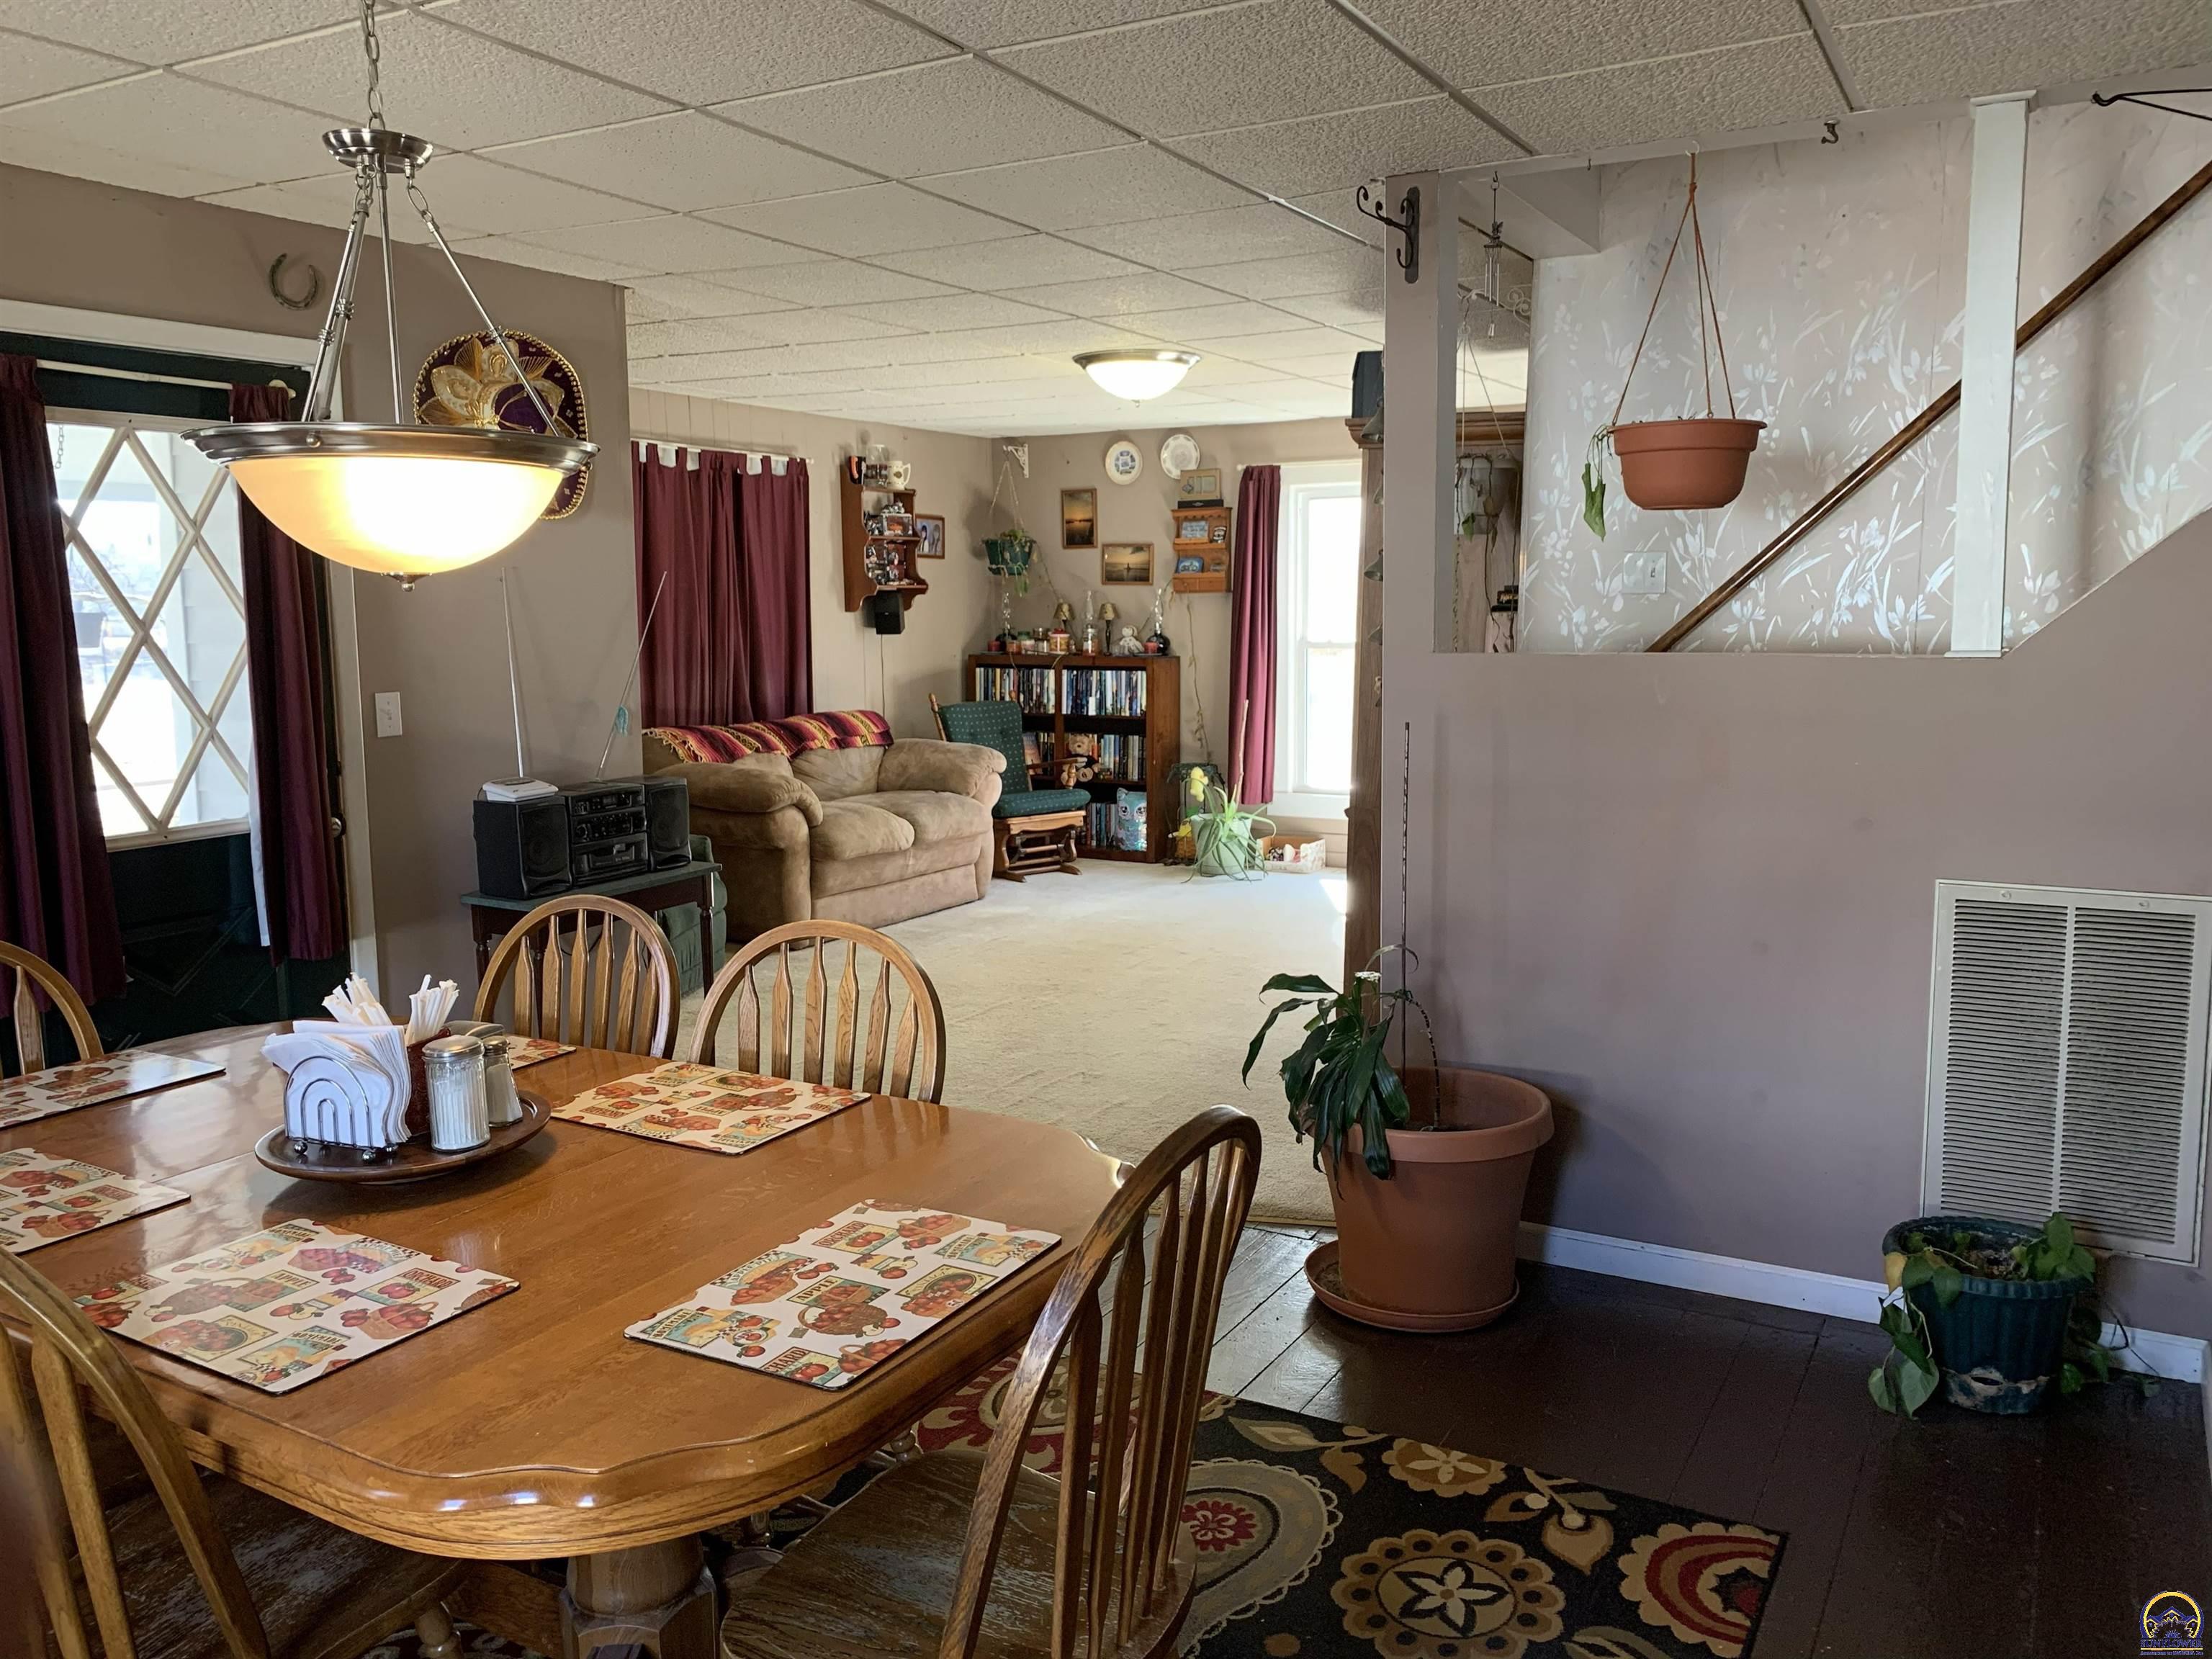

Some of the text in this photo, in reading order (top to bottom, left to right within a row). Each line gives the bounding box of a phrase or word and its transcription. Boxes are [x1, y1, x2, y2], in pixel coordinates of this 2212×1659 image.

[819, 1222, 866, 1246] ORCHARD
[271, 1272, 312, 1287] APPLE
[403, 1270, 454, 1288] ORCHARD
[795, 1278, 839, 1301] APPLE
[652, 1310, 691, 1338] HOMEMADE
[291, 1331, 341, 1344] HOMEMADE
[764, 1349, 808, 1373] CHARD
